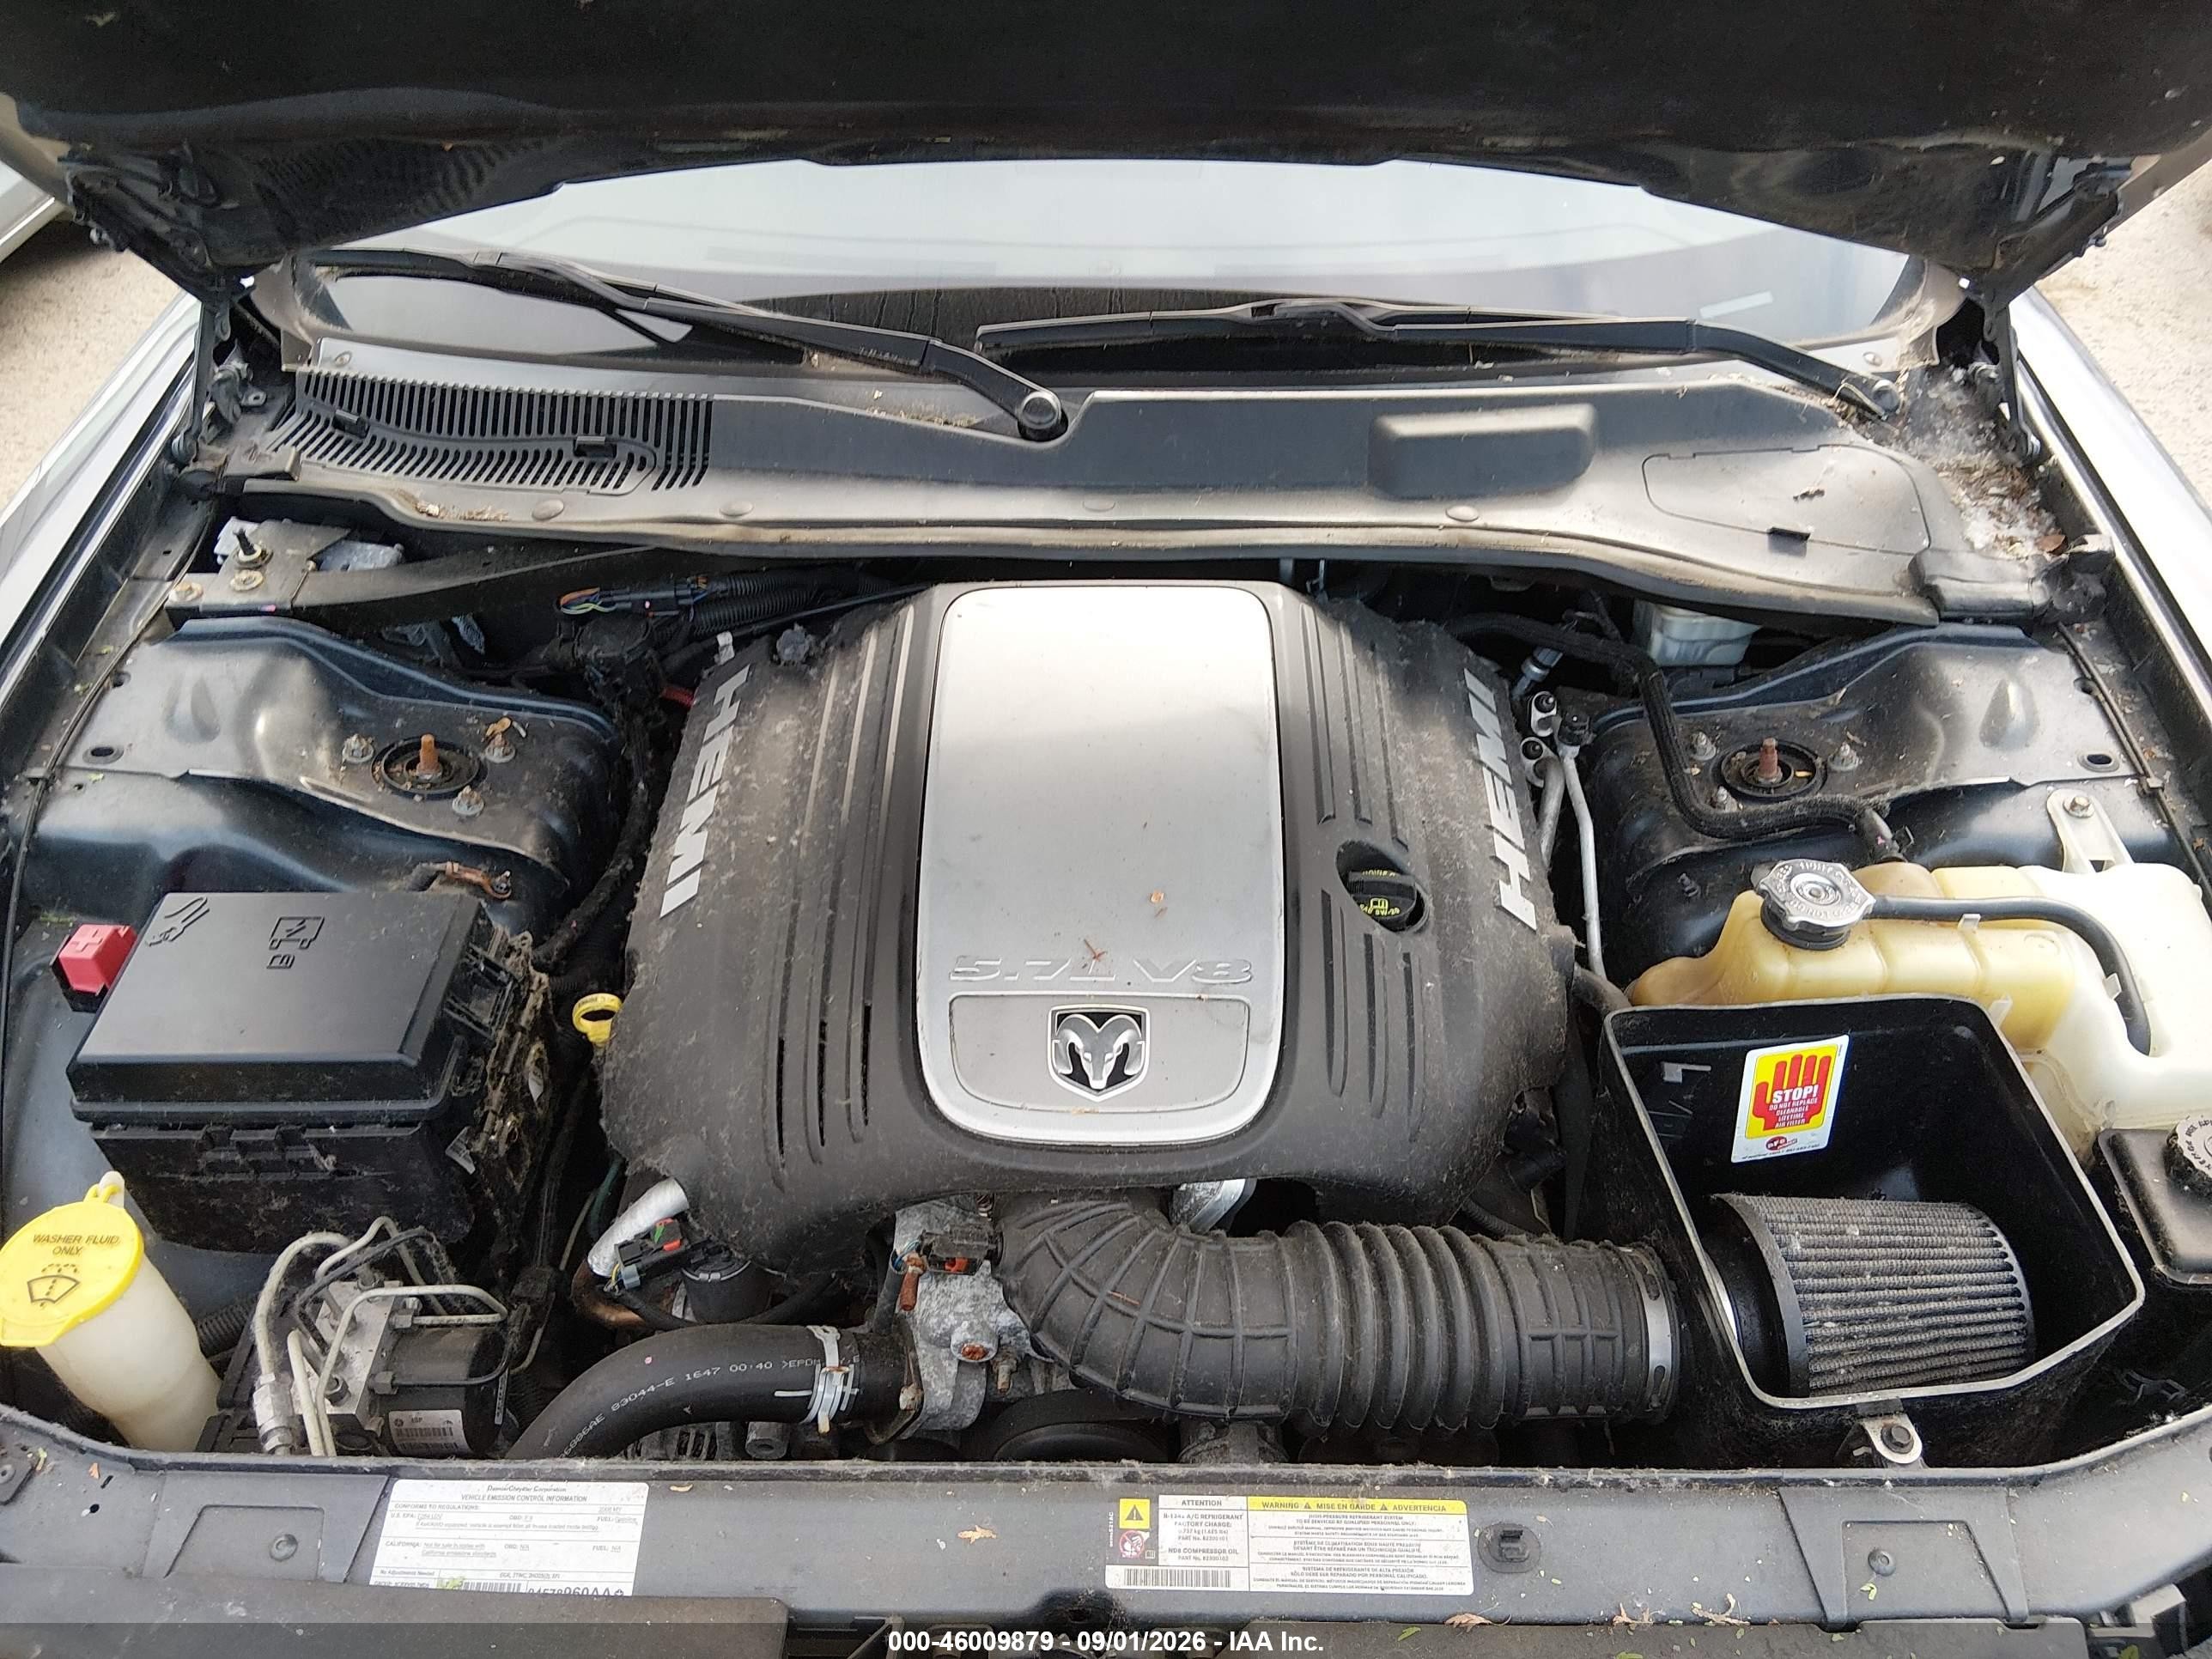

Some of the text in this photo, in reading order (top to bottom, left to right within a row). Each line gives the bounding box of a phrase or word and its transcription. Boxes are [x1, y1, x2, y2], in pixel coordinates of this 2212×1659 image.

[659, 664, 750, 918] HEMI
[1464, 668, 1536, 930] HEMI
[950, 955, 1254, 985] 5.7L V8
[1772, 1085, 1819, 1103] STOP!
[33, 1234, 119, 1244] WASHER FLUID
[52, 1246, 82, 1255] ONLY
[685, 1366, 721, 1382] 1647
